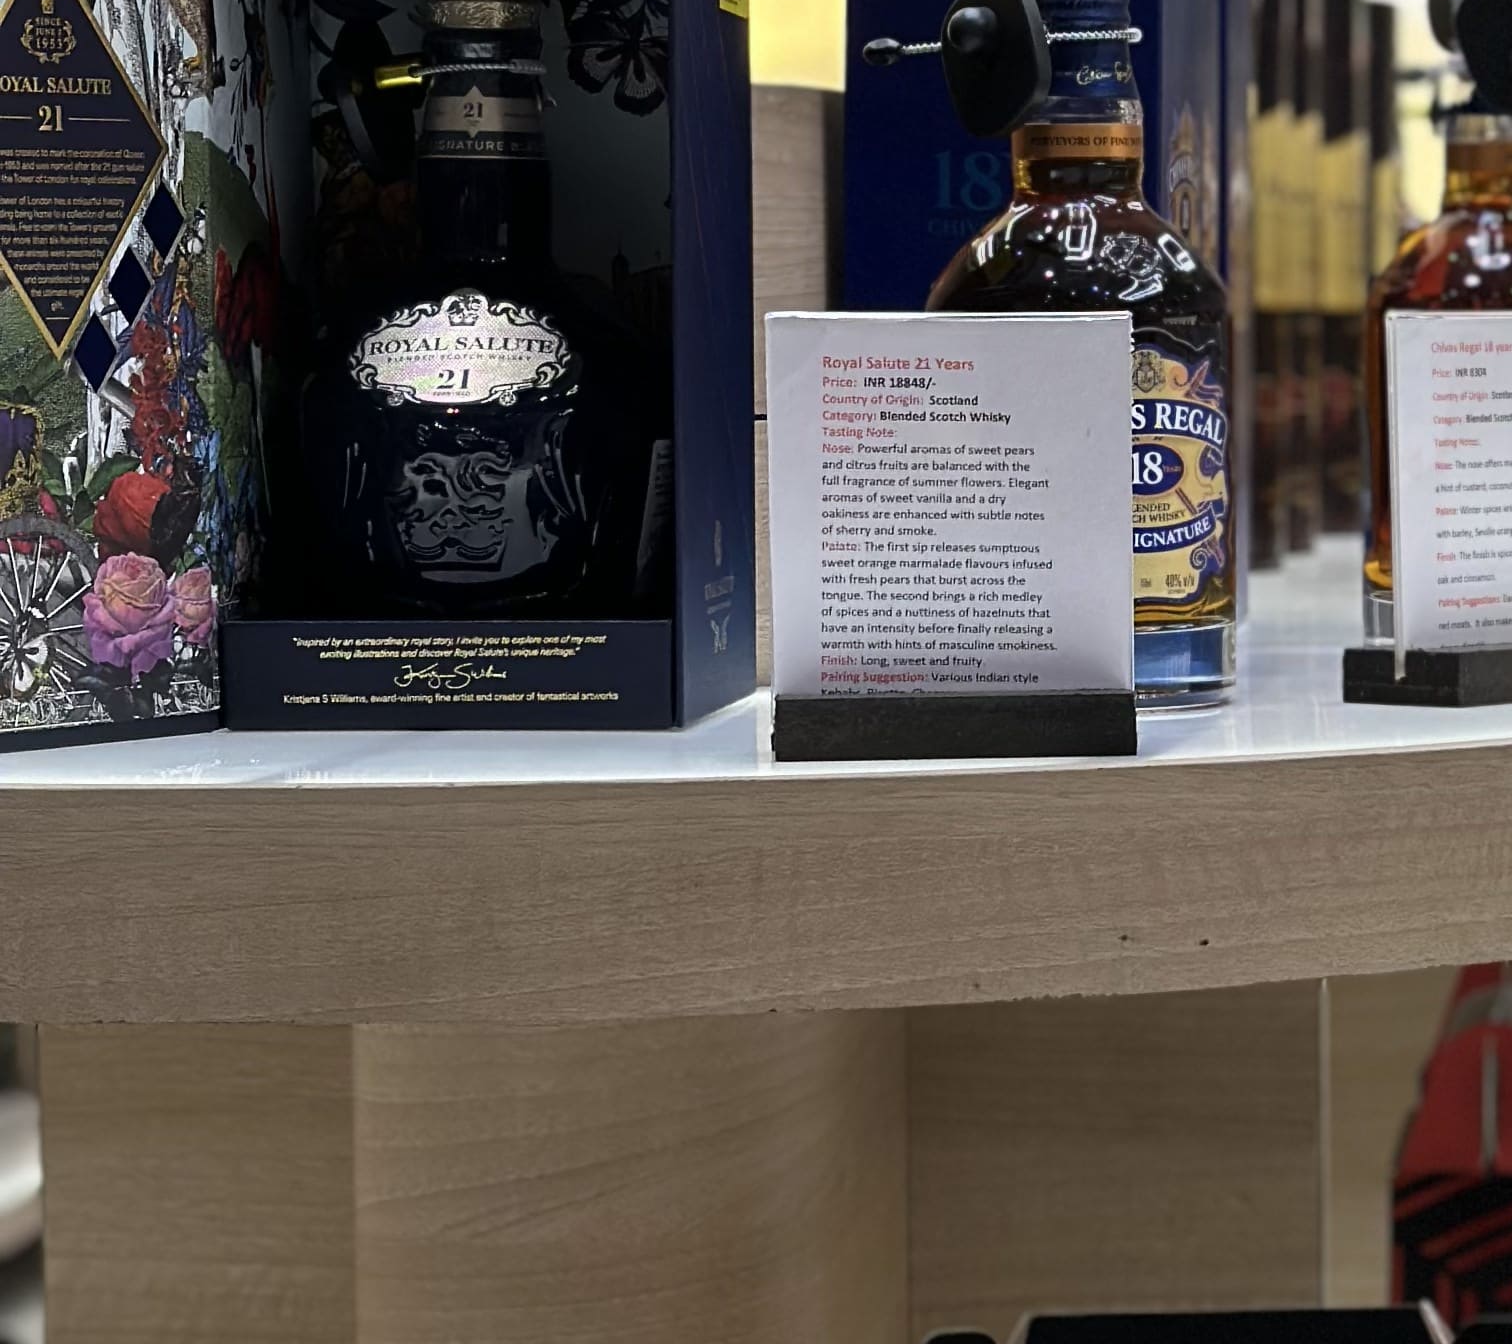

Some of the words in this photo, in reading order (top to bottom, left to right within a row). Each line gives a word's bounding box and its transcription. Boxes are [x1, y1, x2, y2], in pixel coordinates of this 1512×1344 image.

[36, 39, 63, 49] 1953
[0, 75, 44, 93] OYAL
[47, 77, 112, 95] SALUTE
[463, 102, 483, 118] 21
[38, 105, 64, 132] 21
[931, 150, 1002, 211] 18
[928, 218, 980, 236] CHIV
[368, 337, 448, 355] ROYAL
[455, 337, 554, 354] SALUTE
[822, 355, 862, 371] Royal
[866, 356, 910, 369] Salute
[914, 357, 930, 369] 21
[935, 358, 974, 370] Years
[436, 369, 470, 390] 21
[823, 376, 857, 387] Price:
[864, 377, 885, 387] INR
[889, 376, 936, 389] 18848/-
[822, 393, 867, 406] Country
[870, 394, 882, 404] of
[885, 394, 923, 406] Origin:
[929, 395, 978, 405] Scotland
[822, 410, 876, 423] Category:
[880, 410, 926, 421] Blended
[929, 411, 966, 421] Scotch
[970, 412, 1010, 424] Whisky
[1154, 403, 1223, 444] REGAL
[822, 426, 863, 440] Tasting
[866, 427, 896, 437] Note:
[822, 443, 853, 453] Nose:
[857, 442, 907, 453] Powerful
[910, 446, 951, 454] aromas
[954, 444, 965, 454] of
[968, 446, 1001, 455] sweet
[1004, 447, 1034, 457] pears
[822, 459, 842, 469] and
[846, 460, 876, 469] citrus
[879, 459, 908, 470] fruits
[911, 462, 928, 470] are
[932, 460, 981, 471] balanced
[984, 461, 1008, 471] with
[1012, 461, 1030, 471] the
[1132, 452, 1164, 485] 18
[822, 475, 839, 485] full
[842, 475, 895, 488] fragrance
[898, 476, 909, 486] of
[912, 479, 958, 487] summer
[961, 476, 1006, 487] flowers.
[1008, 477, 1048, 490] Elegant
[821, 508, 869, 518] oakiness
[893, 509, 947, 519] enhanced
[950, 510, 974, 519] with
[977, 509, 1011, 520] subtle
[1014, 512, 1044, 520] notes
[1132, 502, 1171, 513] ENDED
[1149, 509, 1186, 522] WHISKY
[821, 524, 833, 534] of
[836, 525, 870, 536] sherry
[874, 525, 894, 535] and
[897, 525, 936, 535] smoke.
[1134, 516, 1212, 548] IGNATURE
[822, 541, 861, 551] Palate:
[864, 541, 884, 551] The
[887, 541, 909, 551] first
[912, 542, 927, 553] sip
[930, 541, 975, 552] releases
[979, 544, 1039, 555] sumptuous
[822, 558, 854, 567] sweet
[858, 560, 896, 569] orange
[899, 558, 962, 568] marmalade
[965, 558, 1008, 568] flavours
[1012, 559, 1052, 569] infused
[821, 574, 845, 583] with
[849, 573, 876, 584] fresh
[880, 577, 910, 586] pears
[913, 574, 936, 584] that
[939, 575, 967, 584] burst
[970, 577, 1004, 585] across
[1007, 575, 1025, 585] the
[822, 591, 863, 602] tongue.
[866, 590, 887, 600] The
[890, 590, 928, 600] second
[932, 591, 966, 603] brings
[969, 593, 975, 601] a
[978, 591, 998, 601] rich
[1002, 591, 1042, 604] medley
[821, 640, 864, 649] warmth
[868, 639, 891, 649] with
[895, 639, 921, 649] hints
[924, 639, 936, 649] of
[939, 640, 994, 650] masculine
[998, 640, 1057, 650] smokiness.
[821, 655, 856, 665] Finish:
[861, 656, 889, 668] Long,
[893, 657, 926, 666] sweet
[928, 655, 949, 668] and
[821, 671, 860, 684] Pairing
[863, 672, 928, 684] Suggestion:
[931, 672, 972, 682] Various
[976, 672, 1009, 682] Indian
[1012, 673, 1038, 684] style
[322, 694, 329, 704] S
[435, 693, 451, 702] fine
